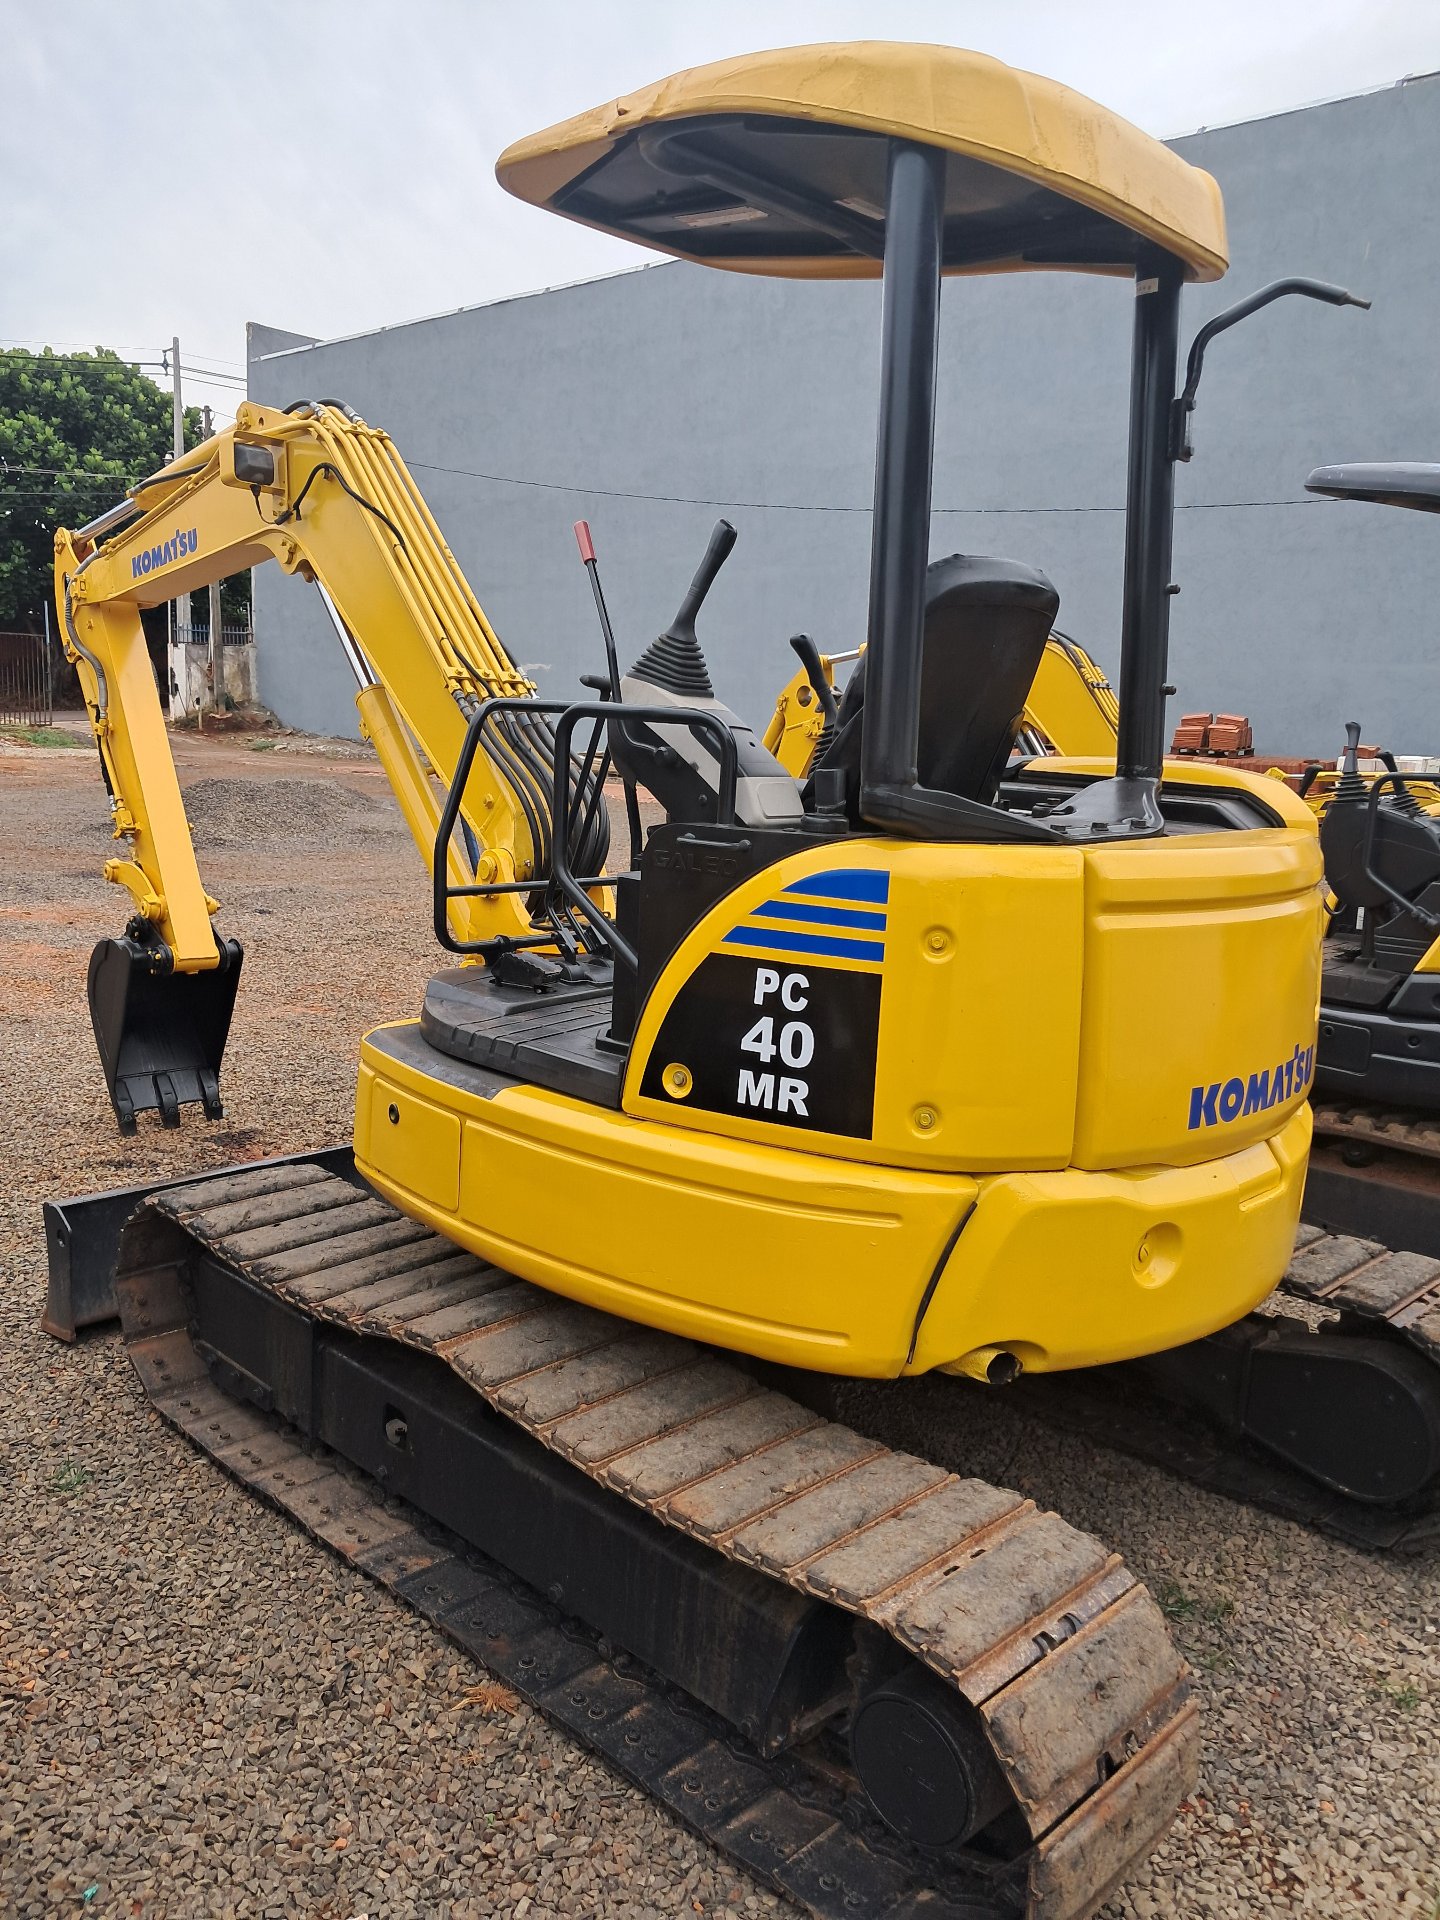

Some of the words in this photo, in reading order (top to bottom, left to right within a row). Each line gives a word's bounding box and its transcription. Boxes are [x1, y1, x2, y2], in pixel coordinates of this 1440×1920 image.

[131, 527, 198, 578] KOMATSU
[654, 849, 738, 877] GALEO
[753, 967, 810, 1012] PC
[740, 1016, 815, 1069] 40
[736, 1069, 810, 1117] MR
[1188, 1043, 1314, 1130] KOMATSU
